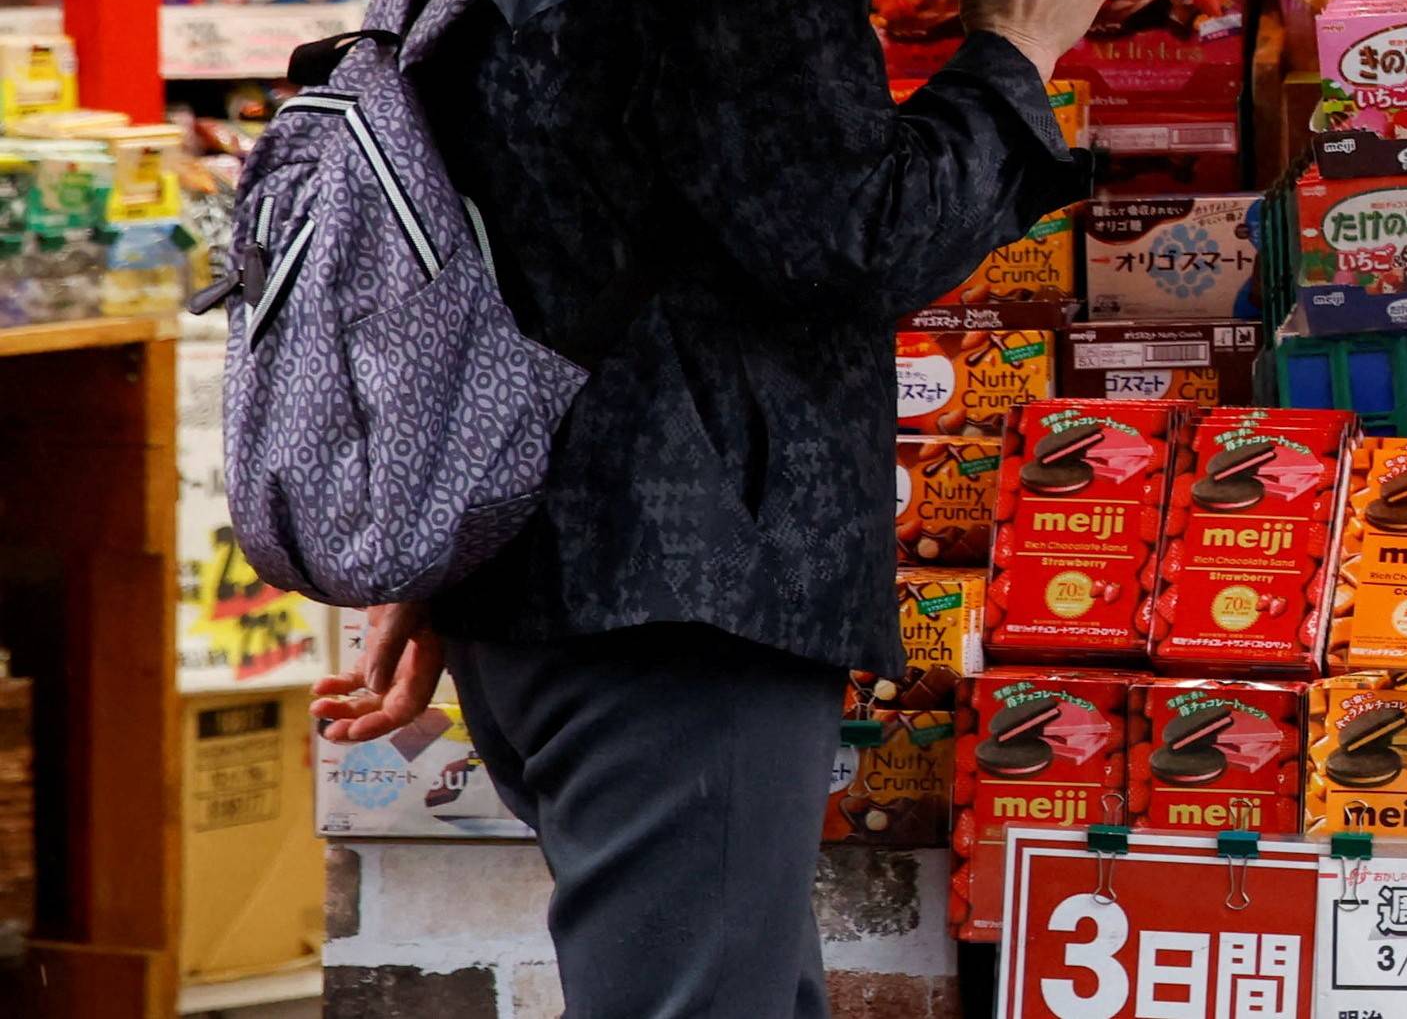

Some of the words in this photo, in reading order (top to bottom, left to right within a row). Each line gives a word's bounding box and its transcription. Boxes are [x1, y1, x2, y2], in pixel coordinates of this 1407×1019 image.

[1116, 249, 1253, 273] オリゴスマート
[966, 369, 1032, 393] Nutty
[1033, 506, 1125, 540] meiji
[1041, 556, 1108, 569] Strawberry
[871, 749, 937, 772] Nutty
[326, 768, 419, 786] オリゴスマート
[865, 770, 945, 792] Crunch
[993, 790, 1088, 828] meiji
[1168, 799, 1261, 828] meiji
[1040, 891, 1302, 1019] 3日間
